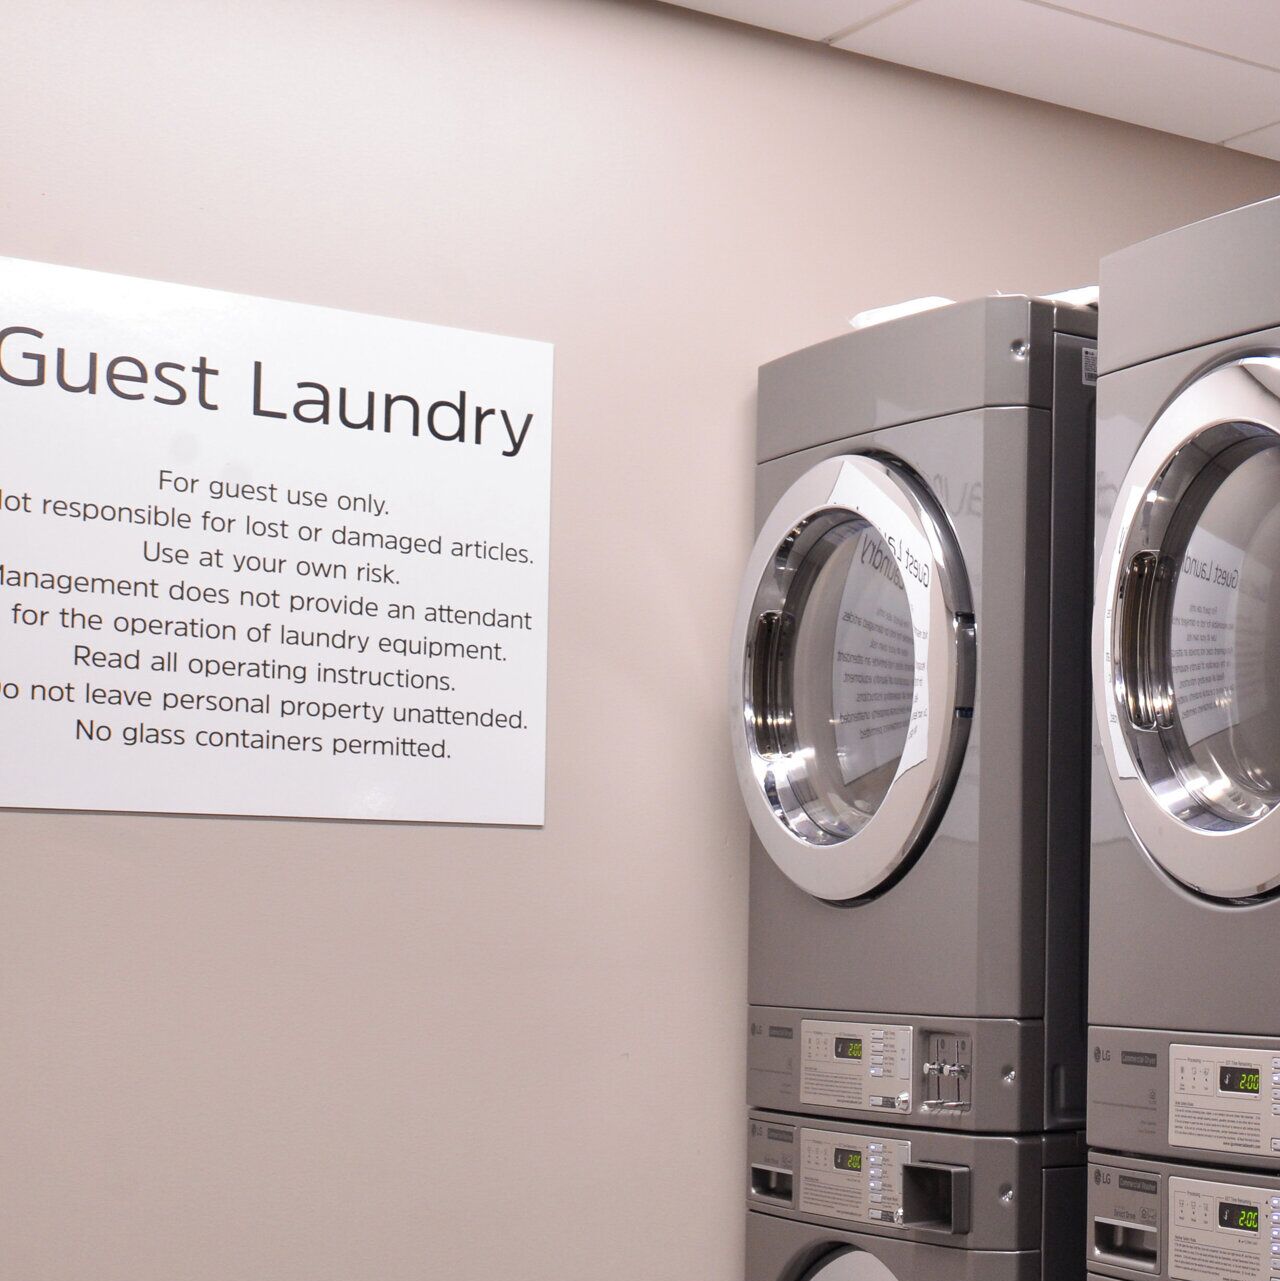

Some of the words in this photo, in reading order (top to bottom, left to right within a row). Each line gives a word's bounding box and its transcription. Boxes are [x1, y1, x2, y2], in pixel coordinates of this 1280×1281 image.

[0, 326, 219, 410] Guest
[253, 361, 533, 457] Laundry
[160, 470, 199, 493] For
[210, 481, 277, 502] guest
[288, 490, 327, 508] use
[338, 494, 389, 516] only.
[0, 489, 31, 513] ot
[43, 499, 191, 529] responsible
[201, 511, 236, 533] for
[247, 515, 289, 539] lost
[298, 526, 322, 542] or
[332, 526, 441, 554] damaged
[451, 541, 533, 564] articles.
[144, 541, 189, 564] Use
[199, 549, 223, 568] at
[233, 555, 286, 573] your
[297, 561, 346, 579] own
[358, 564, 400, 584] risk.
[169, 580, 229, 604] does
[241, 590, 280, 608] not
[290, 595, 378, 617] provide
[388, 604, 414, 620] an
[425, 605, 532, 630] attendant
[12, 603, 49, 626] for
[59, 608, 102, 630] the
[114, 617, 236, 640] operation
[247, 623, 271, 643] of
[281, 625, 369, 653] laundry
[379, 638, 507, 661] equipment.
[75, 645, 139, 670] Read
[151, 652, 177, 672] all
[189, 658, 306, 684] operating
[318, 666, 456, 691] instructions.
[0, 683, 19, 699] o
[31, 683, 75, 702] not
[86, 683, 152, 707] leave
[163, 693, 269, 714] personal
[281, 700, 384, 723] property
[394, 706, 528, 729] unattended.
[77, 719, 111, 741] No
[123, 723, 185, 745] glass
[196, 730, 322, 752] containers
[333, 737, 451, 758] permitted.
[1102, 1050, 1111, 1061] LG
[1102, 1174, 1111, 1185] LG
